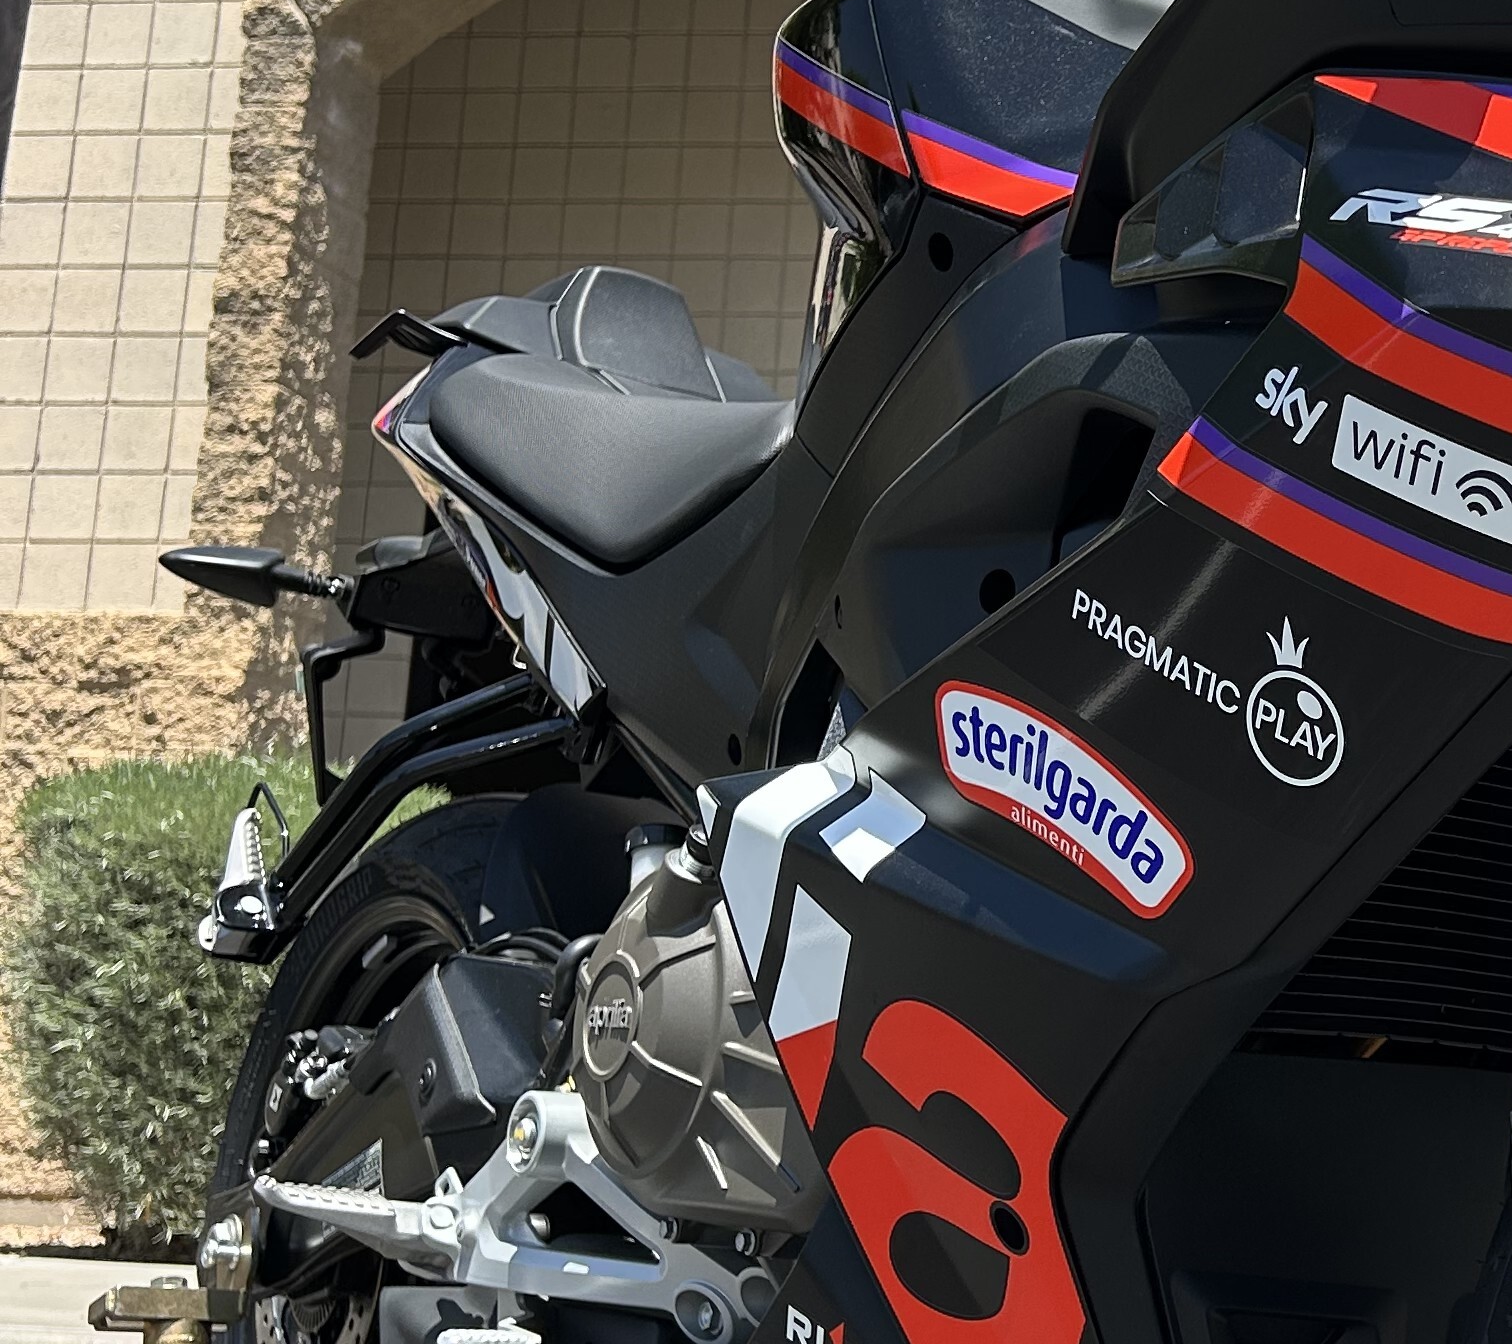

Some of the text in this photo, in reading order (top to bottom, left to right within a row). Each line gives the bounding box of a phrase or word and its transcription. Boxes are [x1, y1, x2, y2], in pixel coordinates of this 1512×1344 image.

[1255, 365, 1328, 444] sky
[1350, 418, 1447, 497] wifi
[1071, 588, 1337, 761] PRAGMATIC PLAY
[951, 705, 1165, 885] sterilgarda
[1010, 804, 1085, 868] alimenti
[588, 998, 633, 1036] aprilia
